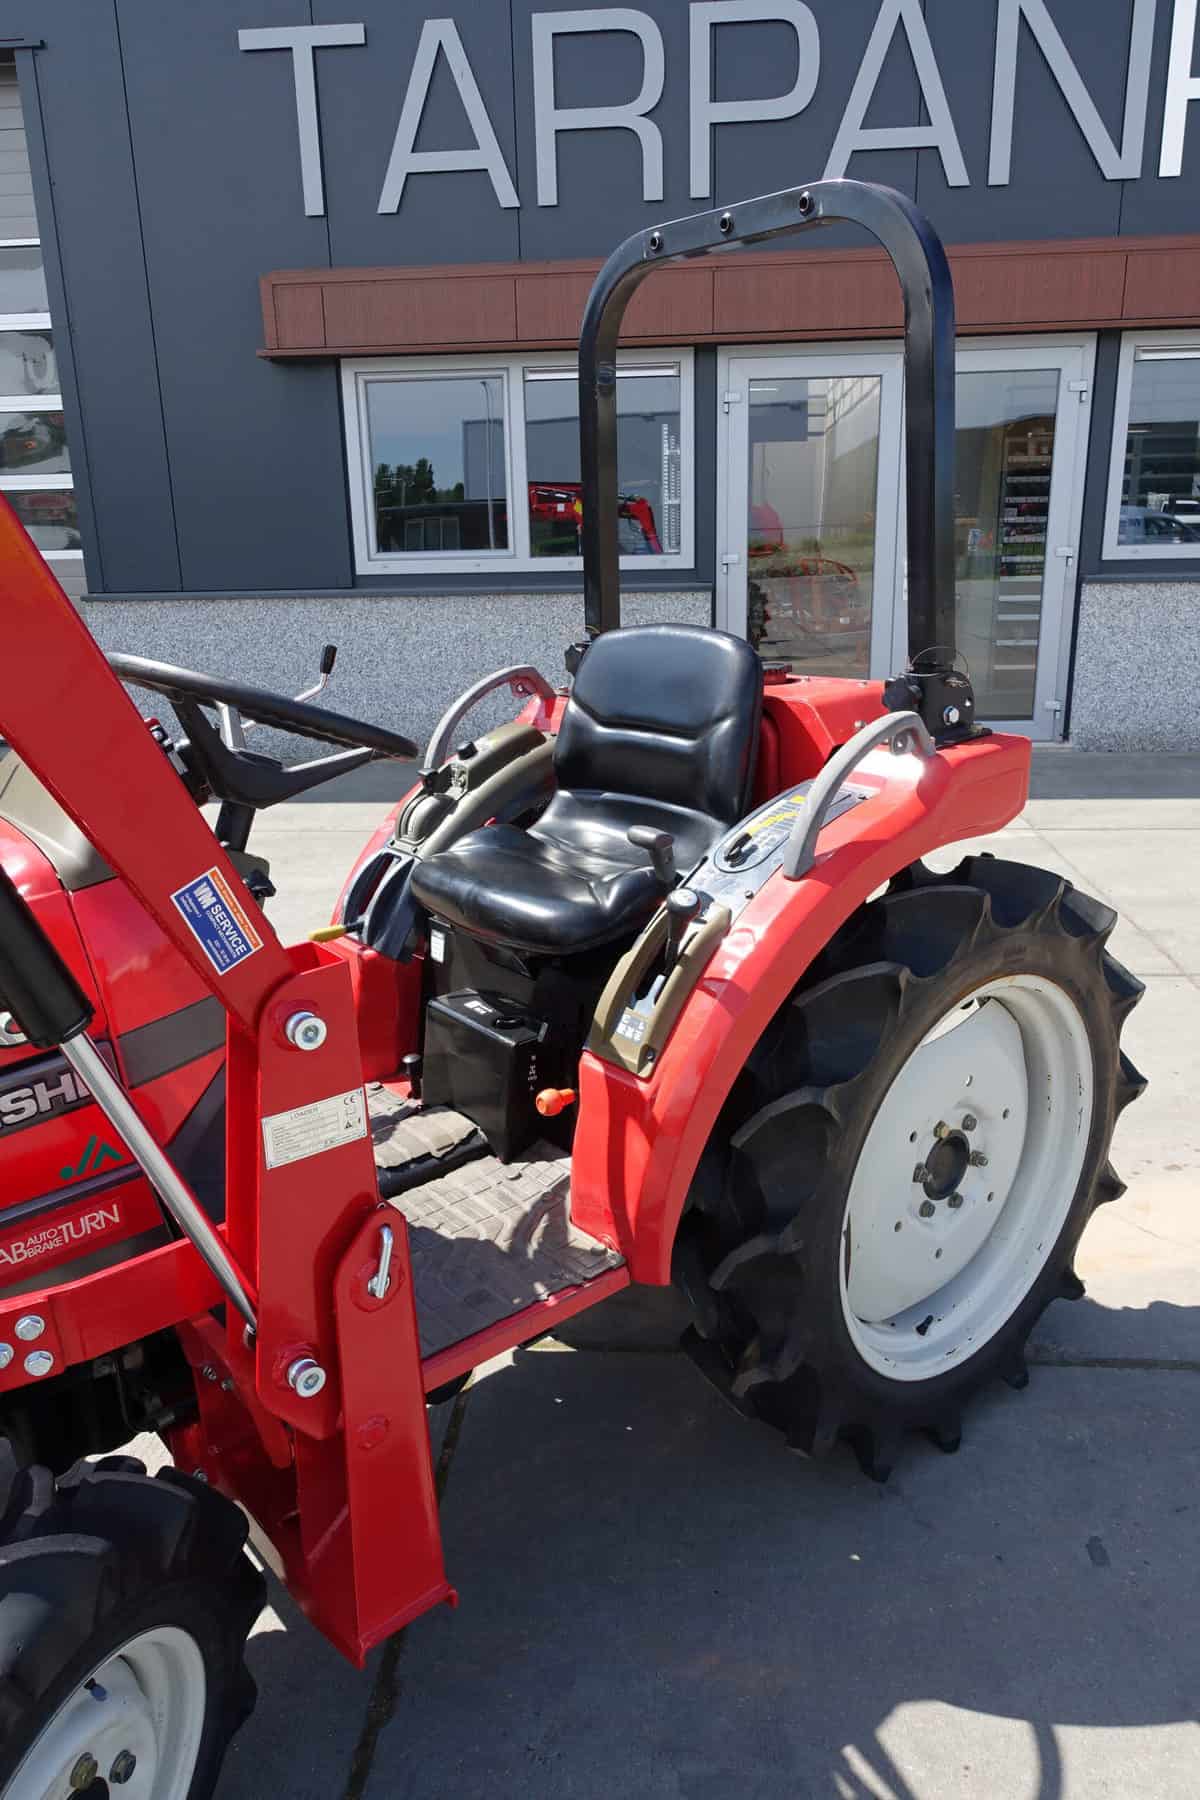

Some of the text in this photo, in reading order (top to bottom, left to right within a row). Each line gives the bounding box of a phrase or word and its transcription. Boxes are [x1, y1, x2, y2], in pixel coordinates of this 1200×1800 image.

[211, 904, 247, 955] SERVICE
[26, 1228, 59, 1248] AUTO
[27, 1237, 64, 1258] BRAKE
